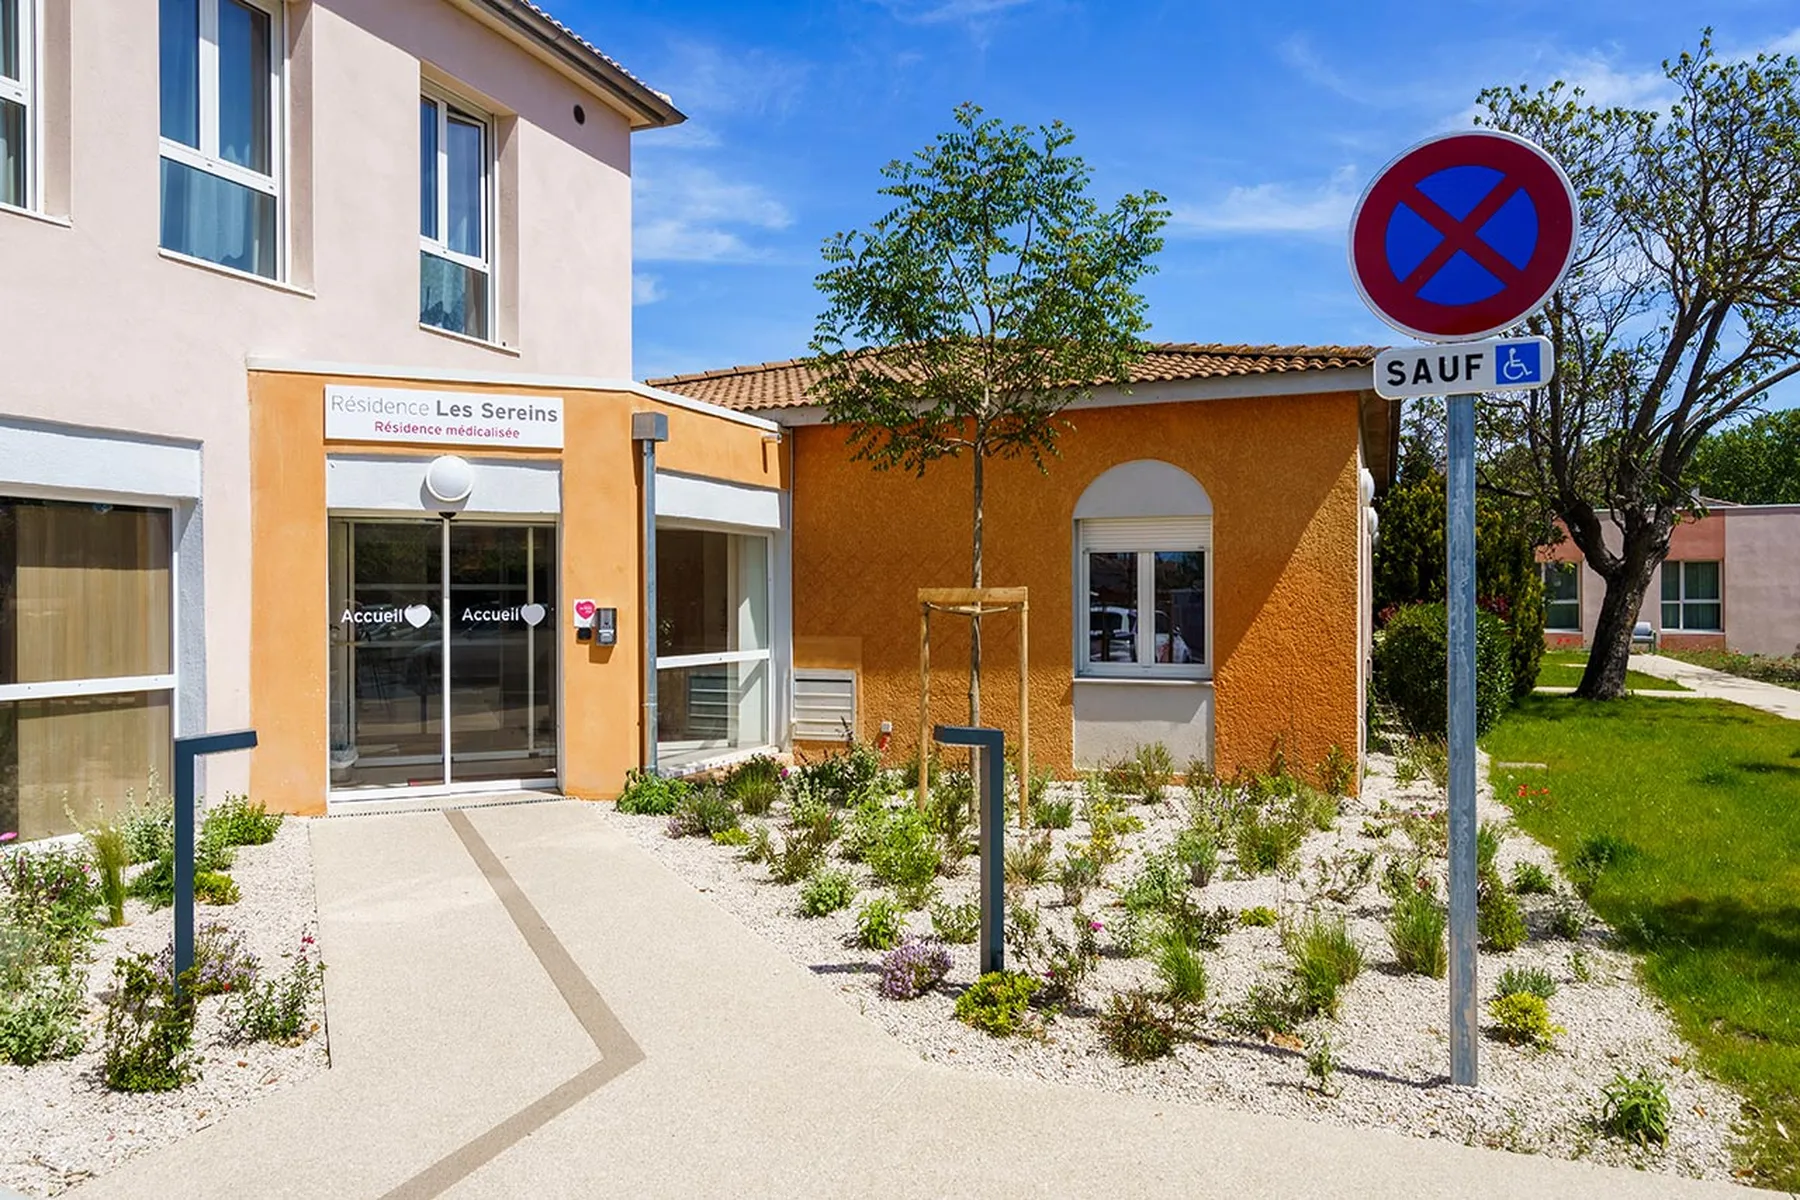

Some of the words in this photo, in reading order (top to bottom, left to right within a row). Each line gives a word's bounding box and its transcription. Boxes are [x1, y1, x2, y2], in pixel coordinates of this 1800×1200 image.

[1387, 353, 1483, 386] SAUF
[331, 394, 430, 417] Résidence
[436, 400, 473, 418] Les
[481, 402, 558, 422] Sereins
[374, 420, 442, 436] Résidence
[446, 423, 520, 439] médicalisée
[341, 608, 403, 623] Accueil
[462, 607, 519, 622] Accueil
